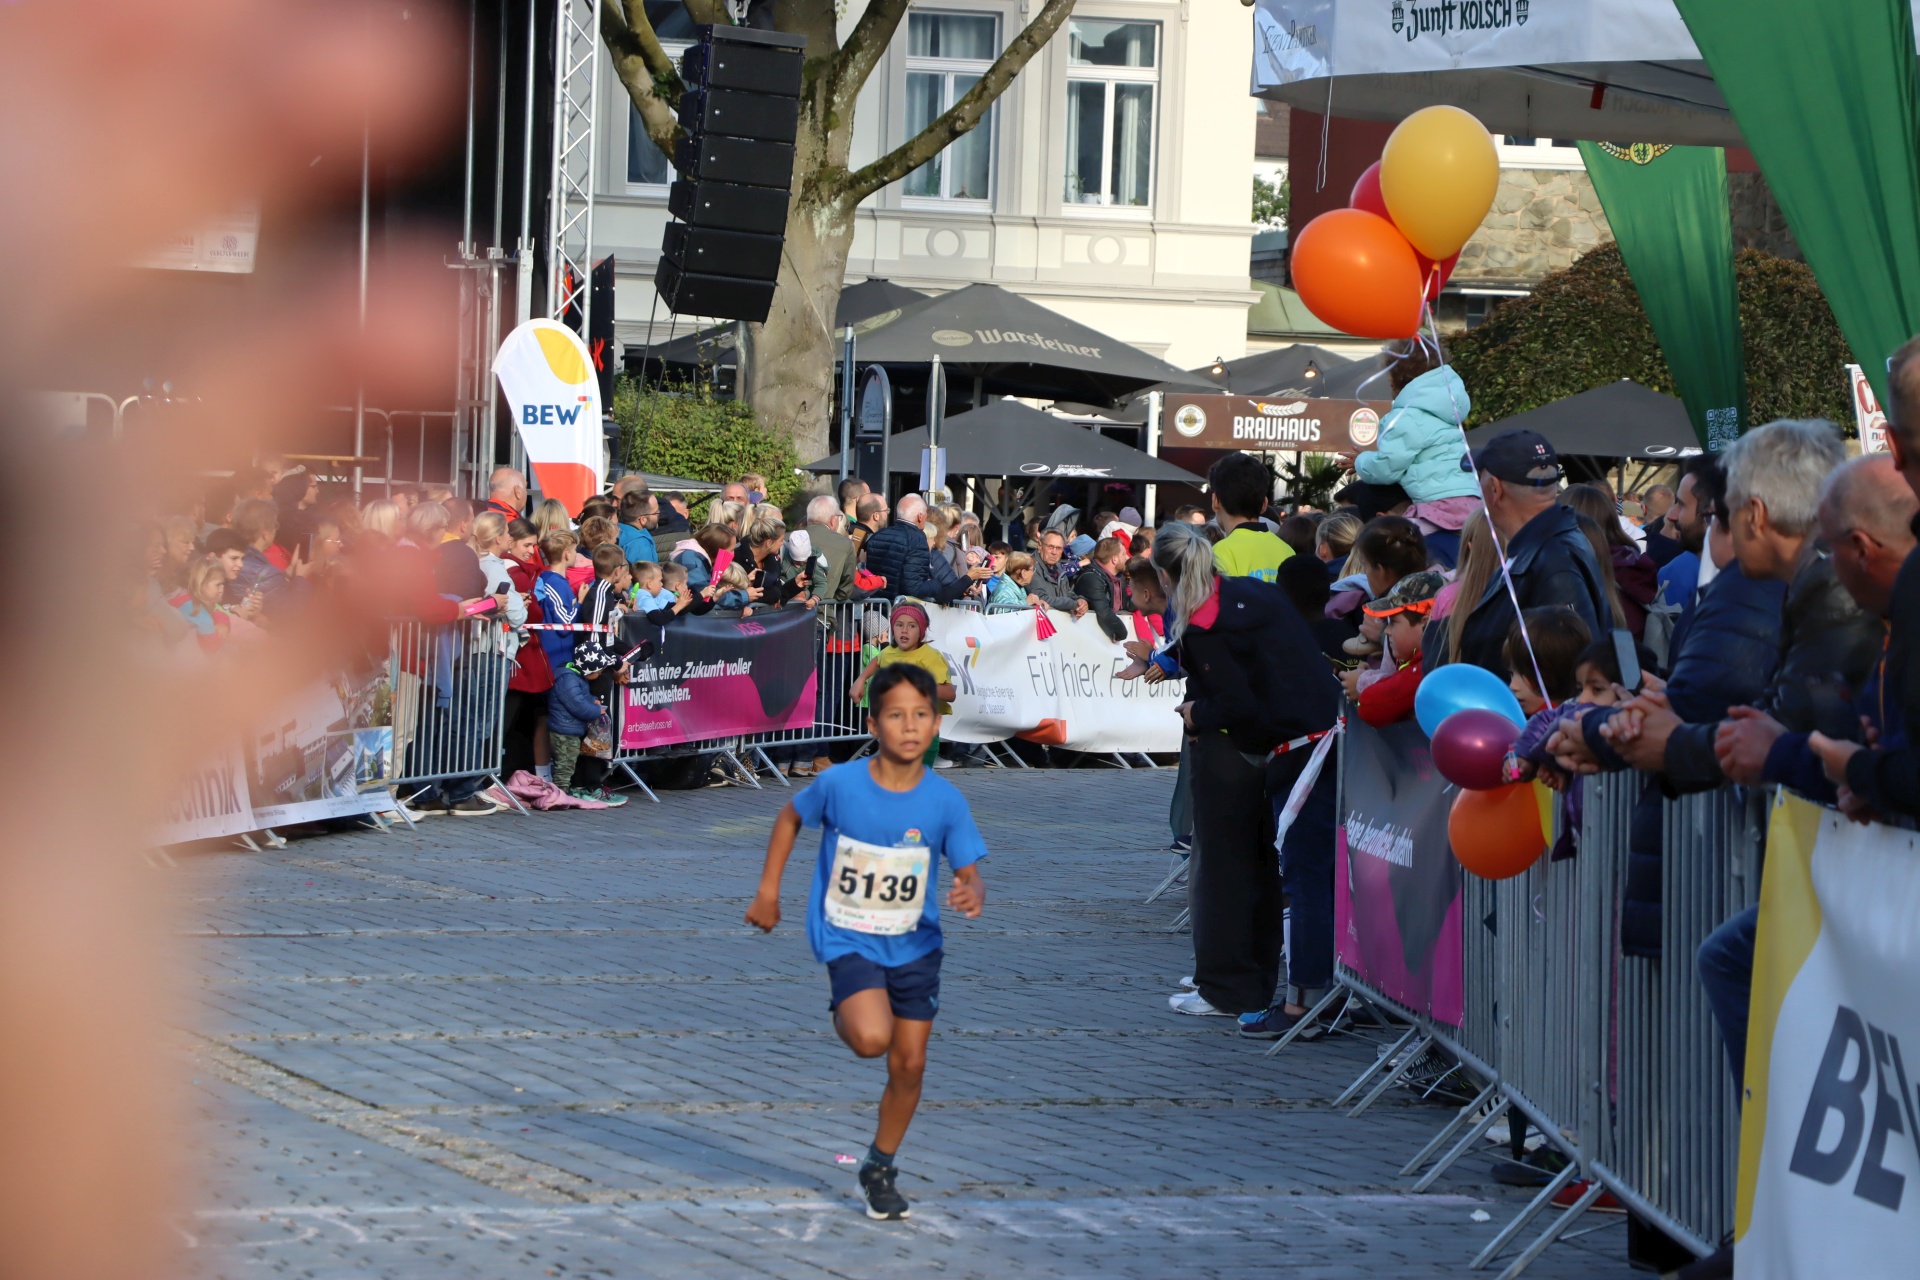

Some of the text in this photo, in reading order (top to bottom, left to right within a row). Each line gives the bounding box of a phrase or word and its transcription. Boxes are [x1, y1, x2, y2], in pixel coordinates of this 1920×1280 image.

[975, 329, 1103, 359] Warsteiner
[522, 404, 583, 426] BEW
[1233, 415, 1321, 442] BRAUHAUS
[682, 659, 725, 679] Zukunft
[726, 657, 752, 676] voller
[1060, 652, 1104, 698] hier.
[838, 866, 918, 902] 5139
